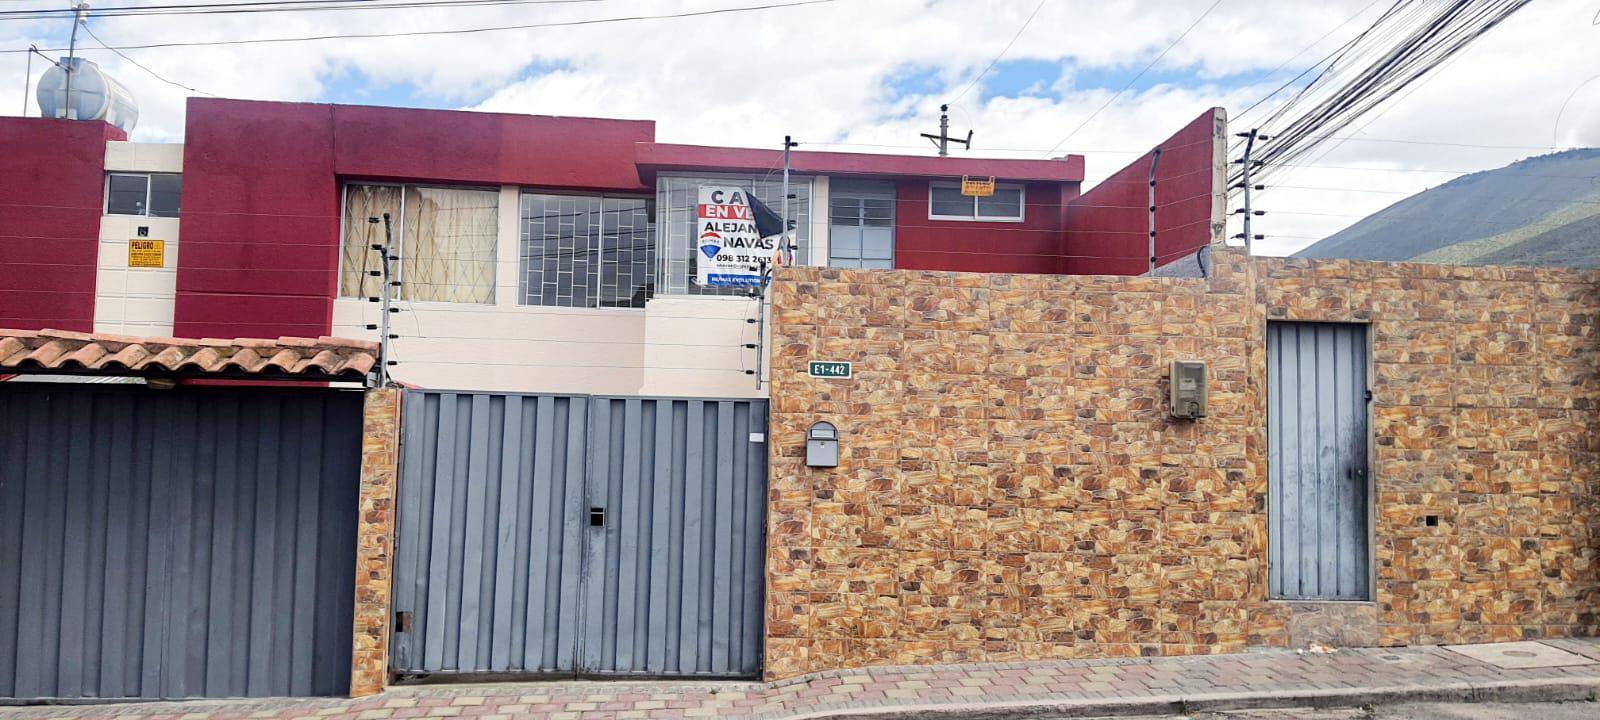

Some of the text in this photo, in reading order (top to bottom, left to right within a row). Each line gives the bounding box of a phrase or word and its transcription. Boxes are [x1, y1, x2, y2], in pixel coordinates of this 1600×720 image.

[705, 205, 729, 217] EN
[131, 241, 153, 249] PELIGRO
[723, 237, 773, 249] NAVAS
[716, 254, 734, 262] 098
[736, 255, 750, 263] 312
[814, 364, 845, 375] E1-442
